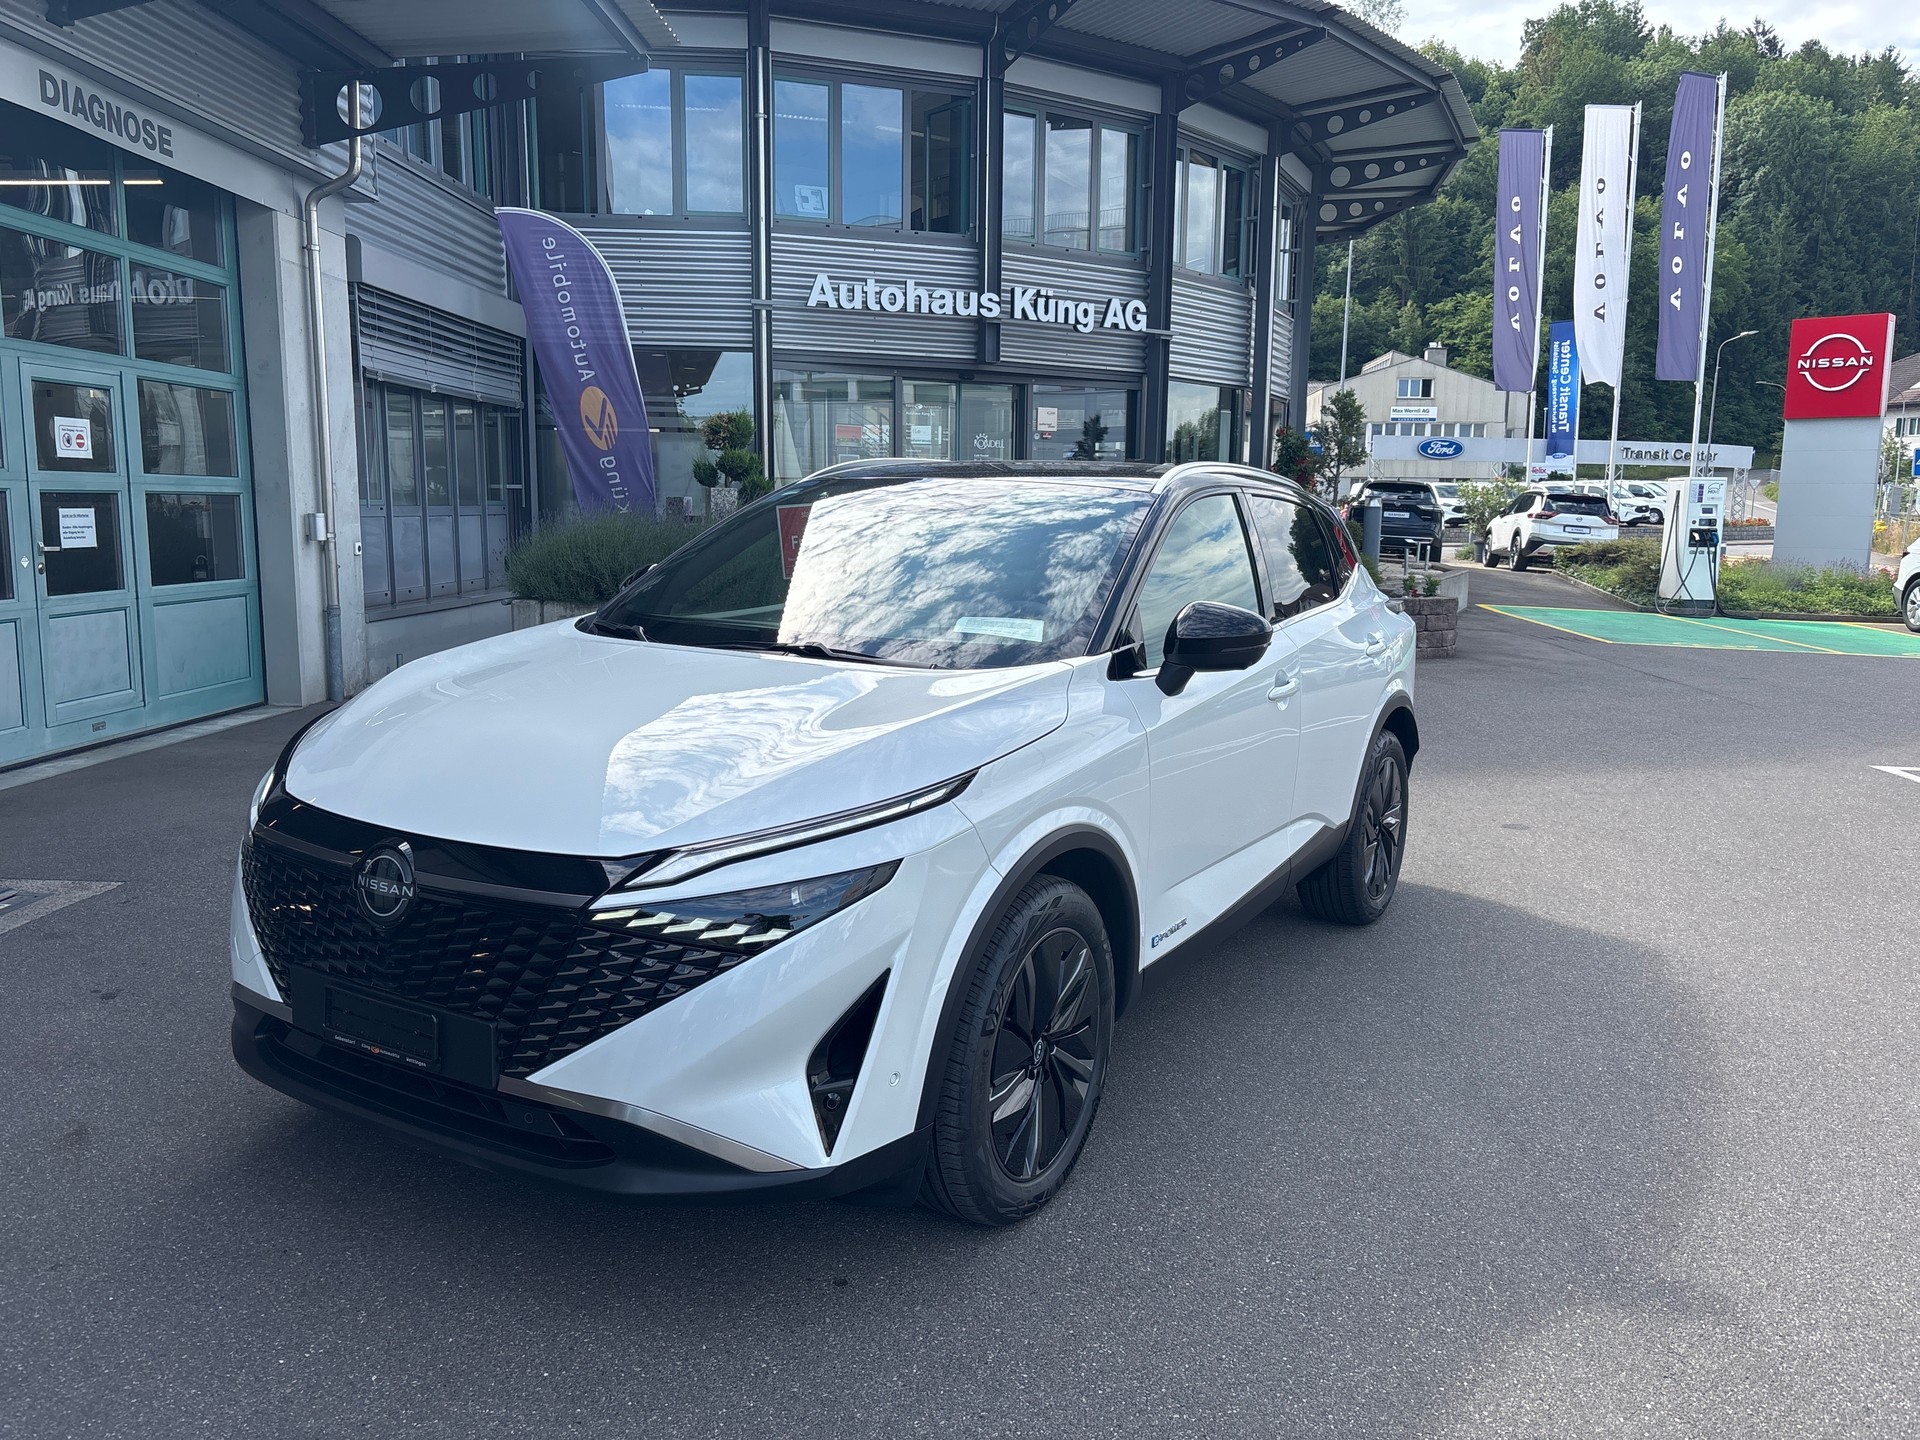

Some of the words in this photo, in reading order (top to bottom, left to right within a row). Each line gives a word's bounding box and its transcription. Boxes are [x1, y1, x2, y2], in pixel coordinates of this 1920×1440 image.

[38, 69, 174, 158] DIAGNOSE
[806, 273, 1001, 319] Autohaus
[1012, 286, 1096, 333] Küng
[1103, 298, 1148, 332] AG
[1797, 355, 1874, 370] NISSAN
[1427, 440, 1456, 455] Ford
[1621, 447, 1669, 461] Transit
[358, 874, 414, 897] NISSAN
